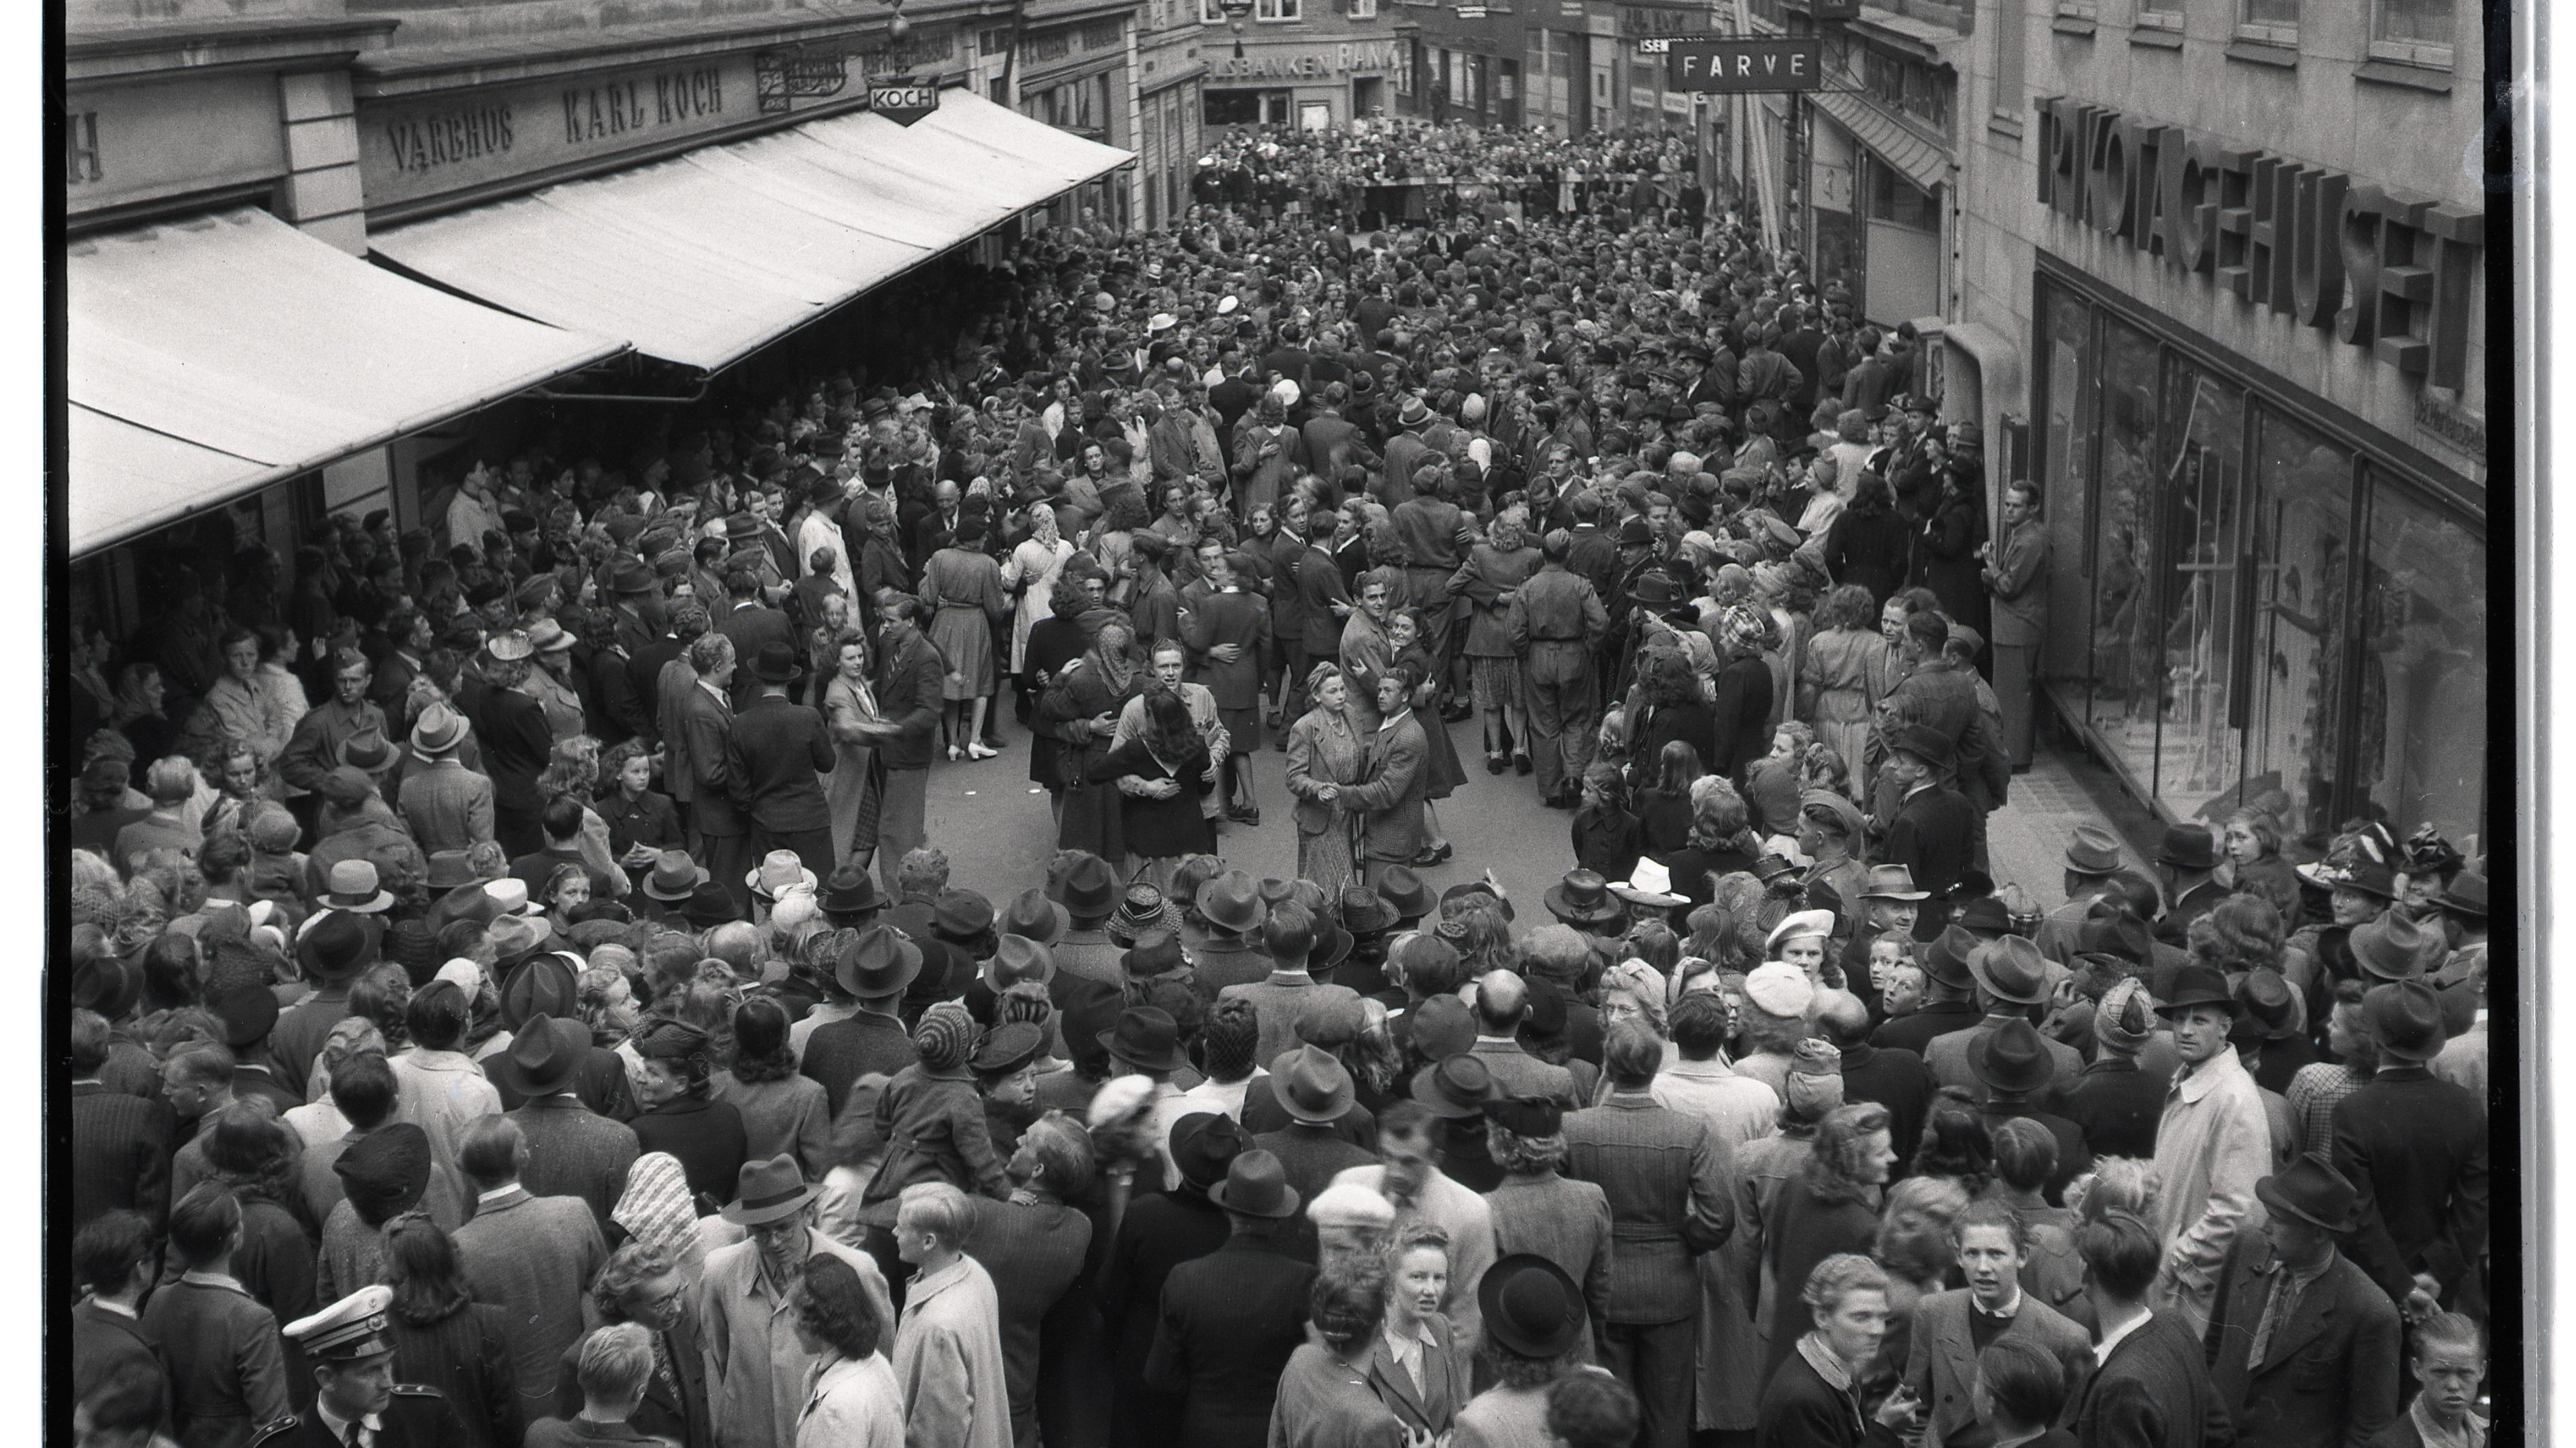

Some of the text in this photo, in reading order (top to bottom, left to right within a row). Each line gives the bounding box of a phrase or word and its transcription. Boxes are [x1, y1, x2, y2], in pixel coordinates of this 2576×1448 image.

[1683, 53, 1806, 77] FARVE
[388, 68, 722, 171] VAREHUS KARL KOCH
[873, 90, 933, 107] KOCH
[2034, 95, 2485, 391] TRIKOTAGEHUSET
